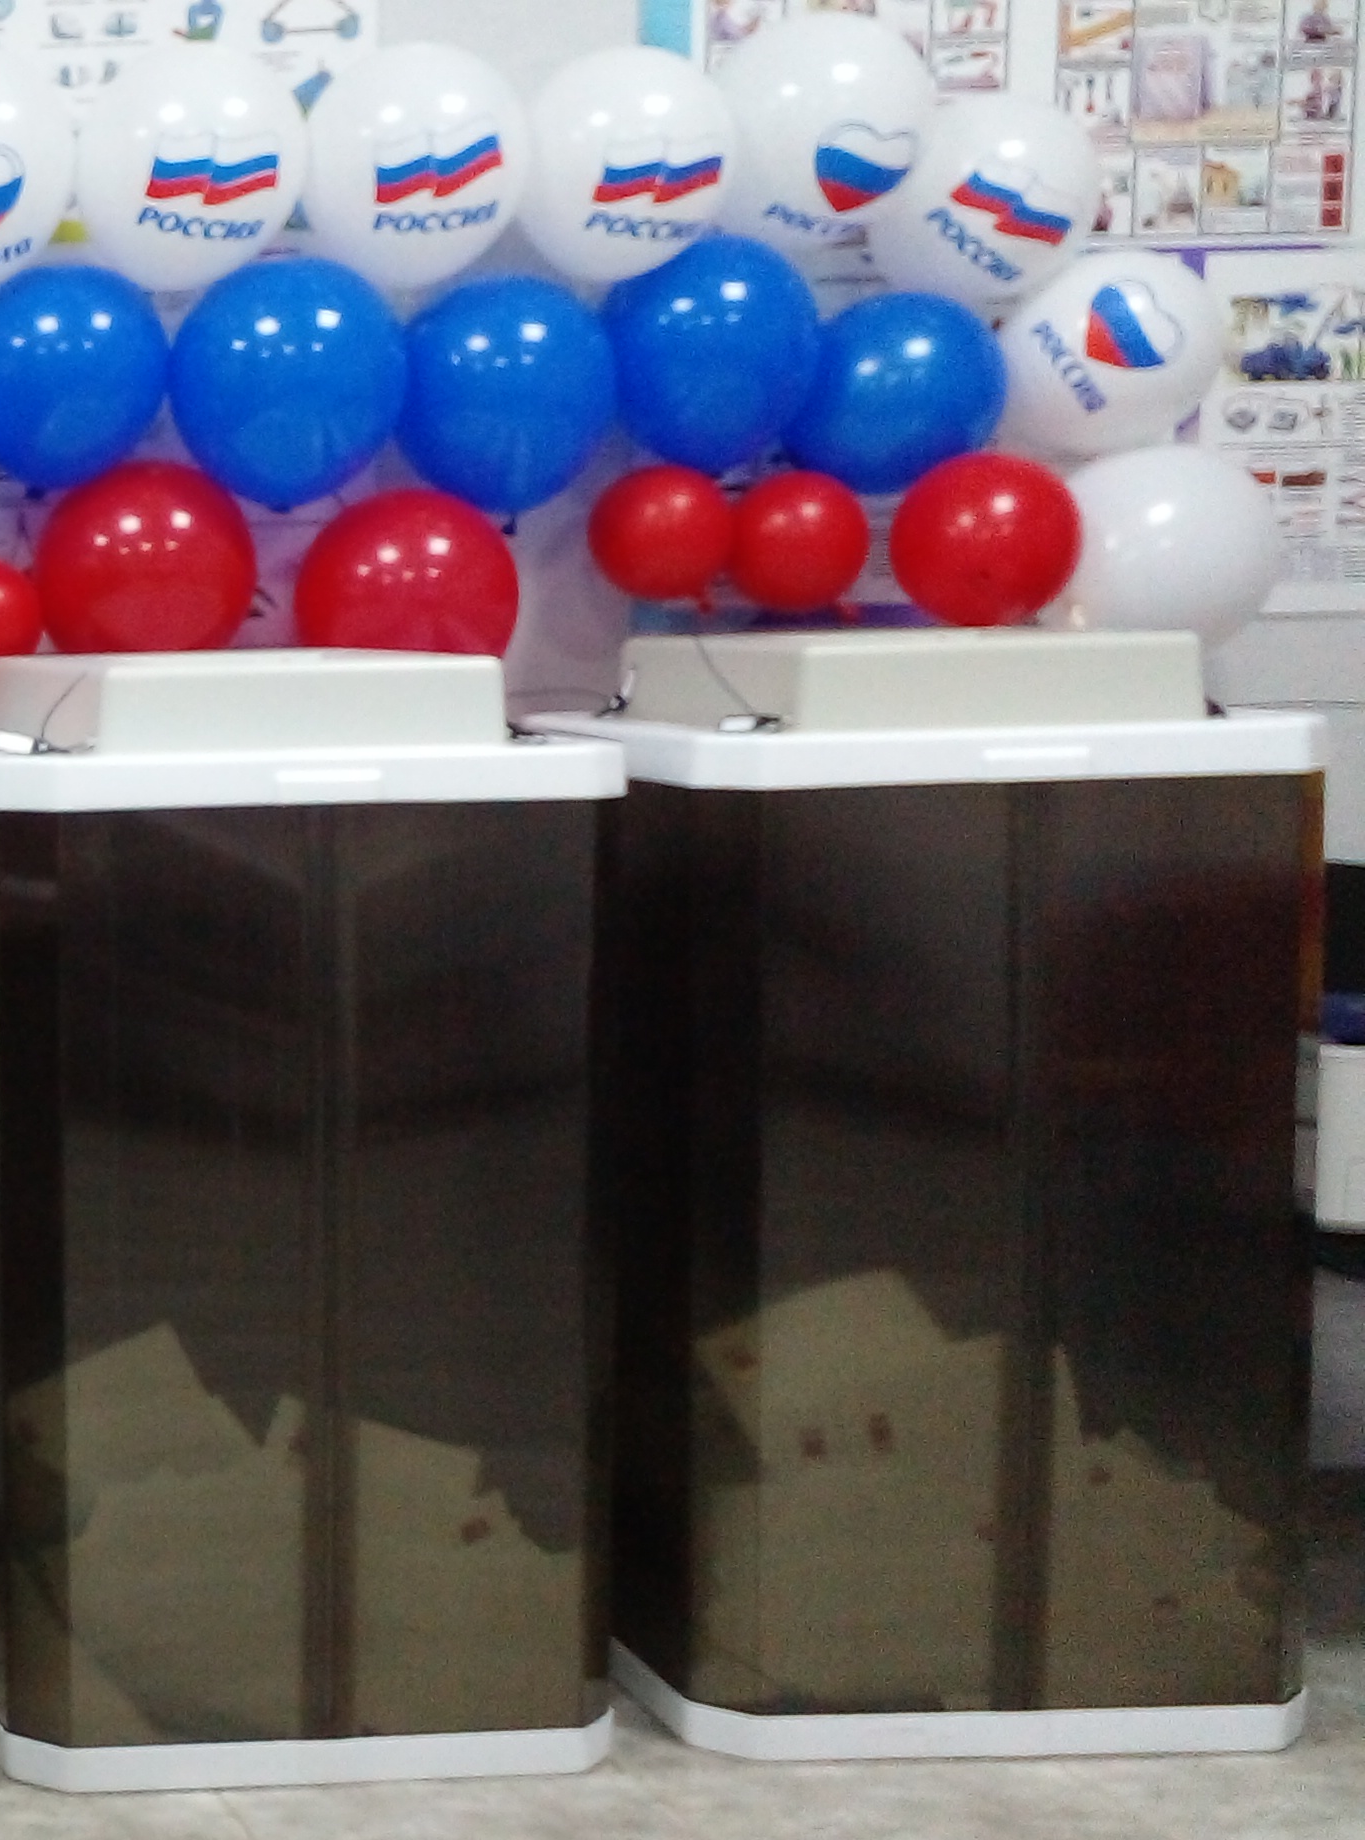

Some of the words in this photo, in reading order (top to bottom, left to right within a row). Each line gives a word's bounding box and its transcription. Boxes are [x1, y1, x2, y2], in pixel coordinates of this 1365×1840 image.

[135, 206, 265, 238] РОССИЯ
[373, 199, 497, 231] РОССИЯ
[926, 208, 1022, 282] РОССИЯ
[1031, 319, 1108, 413] РОССИЯ
